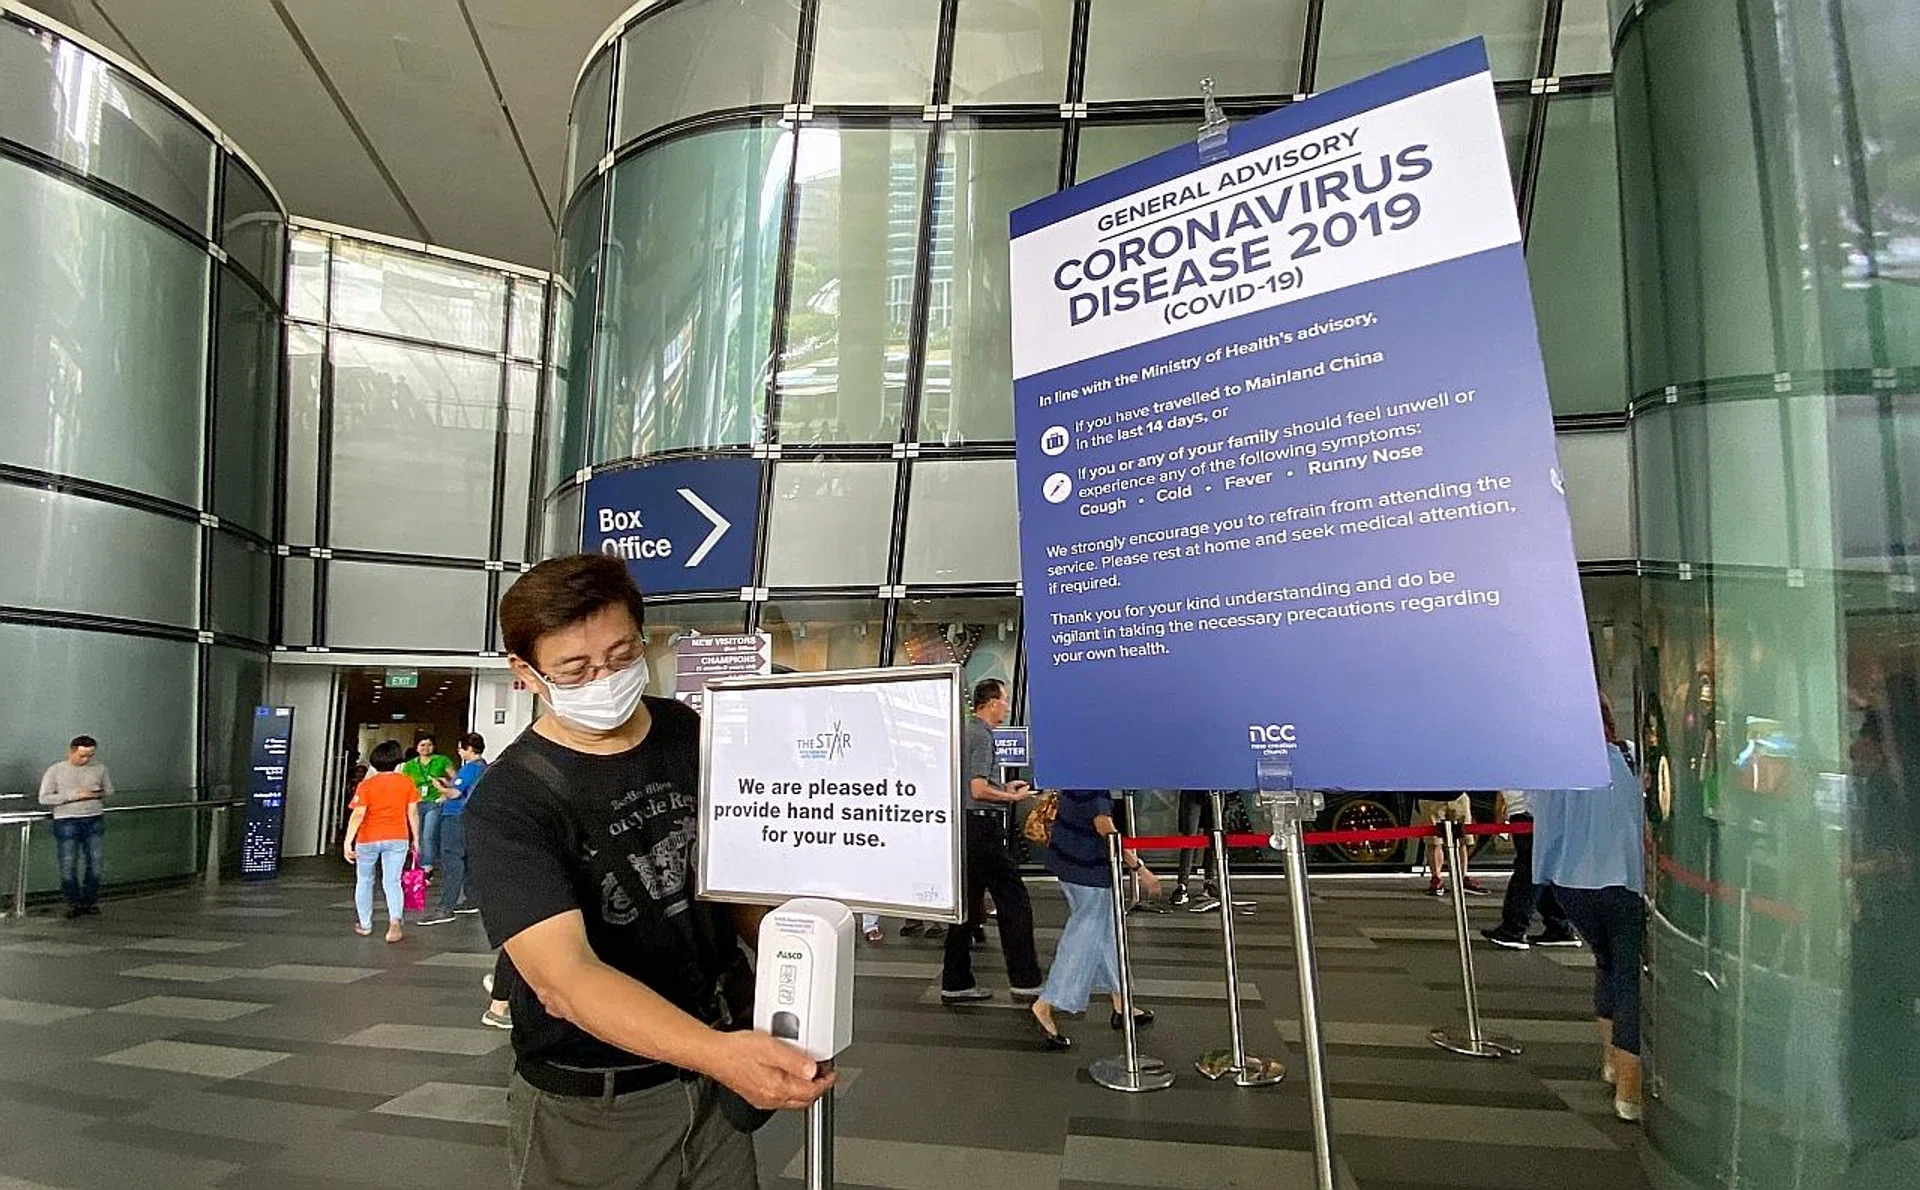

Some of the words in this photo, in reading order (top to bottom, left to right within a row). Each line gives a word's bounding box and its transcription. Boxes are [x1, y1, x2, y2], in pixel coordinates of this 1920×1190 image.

[1098, 181, 1210, 232] GENERAL
[1218, 127, 1360, 191] ADVISORY
[1054, 144, 1433, 291] CORONAVIRUS
[1069, 235, 1272, 326] DISEASE
[1289, 192, 1422, 260] 2019
[1163, 266, 1304, 324] (COVID-19)
[1039, 395, 1051, 407] In
[1055, 388, 1078, 403] line
[1082, 378, 1111, 396] with
[1114, 372, 1139, 387] the
[1141, 356, 1201, 380] Ministry
[1205, 348, 1222, 363] of
[1225, 332, 1292, 358] Health's
[1298, 312, 1378, 340] advisory,
[1075, 421, 1084, 433] If
[1086, 415, 1112, 432] you
[1115, 407, 1150, 422] have
[1153, 387, 1220, 414] travelled
[1225, 385, 1241, 397] to
[1245, 362, 1325, 392] Mainland
[1329, 351, 1383, 371] China
[1089, 464, 1116, 480] you
[1119, 459, 1134, 471] or
[1137, 452, 1165, 468] any
[1169, 447, 1185, 461] of
[1187, 440, 1224, 458] your
[1227, 428, 1279, 453] family
[1283, 413, 1342, 438] should
[1346, 405, 1381, 426] feel
[1387, 392, 1449, 418] unwell
[1454, 389, 1476, 405] or
[1090, 432, 1114, 447] the
[1117, 425, 1144, 441] last
[1146, 421, 1163, 434] 14
[1167, 412, 1208, 430] days,
[1212, 406, 1229, 419] or
[1079, 473, 1155, 498] experience
[1159, 468, 1186, 484] any
[1189, 463, 1206, 477] of
[1209, 457, 1235, 473] the
[1239, 441, 1317, 466] following
[1321, 422, 1422, 452] symptoms:
[1080, 498, 1126, 516] Cough
[1156, 485, 1192, 501] Cold
[1225, 471, 1273, 490] Fever
[1308, 453, 1368, 475] Runny
[1373, 444, 1423, 464] Nose
[599, 508, 643, 532] Box
[1046, 546, 1067, 558] We
[1070, 536, 1126, 555] strongly
[1129, 523, 1210, 544] encourage
[1214, 517, 1243, 535] you
[1248, 514, 1264, 527] to
[1270, 502, 1326, 523] refrain
[1330, 496, 1373, 514] from
[1379, 481, 1471, 507] attending
[1476, 475, 1512, 492] the
[601, 536, 672, 559] Office
[1047, 559, 1097, 576] service.
[1102, 552, 1148, 569] Please
[1153, 546, 1182, 562] rest
[1185, 543, 1200, 556] at
[1205, 536, 1251, 554] home
[1255, 529, 1287, 547] and
[1292, 523, 1335, 541] seek
[1340, 511, 1413, 535] medical
[1419, 499, 1517, 524] attention,
[1048, 582, 1057, 595] if
[1060, 575, 1121, 594] required.
[1050, 610, 1091, 625] Thank
[1095, 608, 1122, 623] you
[1125, 604, 1145, 618] for
[1148, 603, 1183, 618] your
[1187, 595, 1221, 611] kind
[1225, 581, 1351, 606] understanding
[1356, 575, 1392, 593] and
[1398, 573, 1423, 588] do
[1429, 570, 1455, 585] be
[1051, 629, 1100, 646] vigilant
[1103, 627, 1116, 639] in
[1119, 621, 1165, 638] taking
[1169, 619, 1194, 633] the
[1198, 611, 1283, 630] necessary
[1287, 599, 1395, 625] precautions
[1401, 588, 1501, 613] regarding
[692, 638, 713, 646] NEW
[715, 636, 757, 646] VISITORS
[701, 656, 757, 664] CHAMPIONS
[1053, 650, 1082, 665] your
[1086, 648, 1116, 660] own
[1119, 641, 1170, 658] health.
[392, 677, 411, 685] EXIT
[797, 739, 815, 749] THE
[995, 739, 1018, 747] UEST
[1249, 724, 1296, 742] ncc
[738, 778, 765, 794] We
[771, 782, 802, 795] are
[808, 779, 888, 799] pleased
[895, 780, 917, 797] to
[713, 802, 781, 821] provide
[787, 803, 834, 820] hand
[841, 804, 947, 824] sanitizers
[762, 825, 788, 843] for
[793, 830, 836, 847] your
[843, 832, 886, 847] use.
